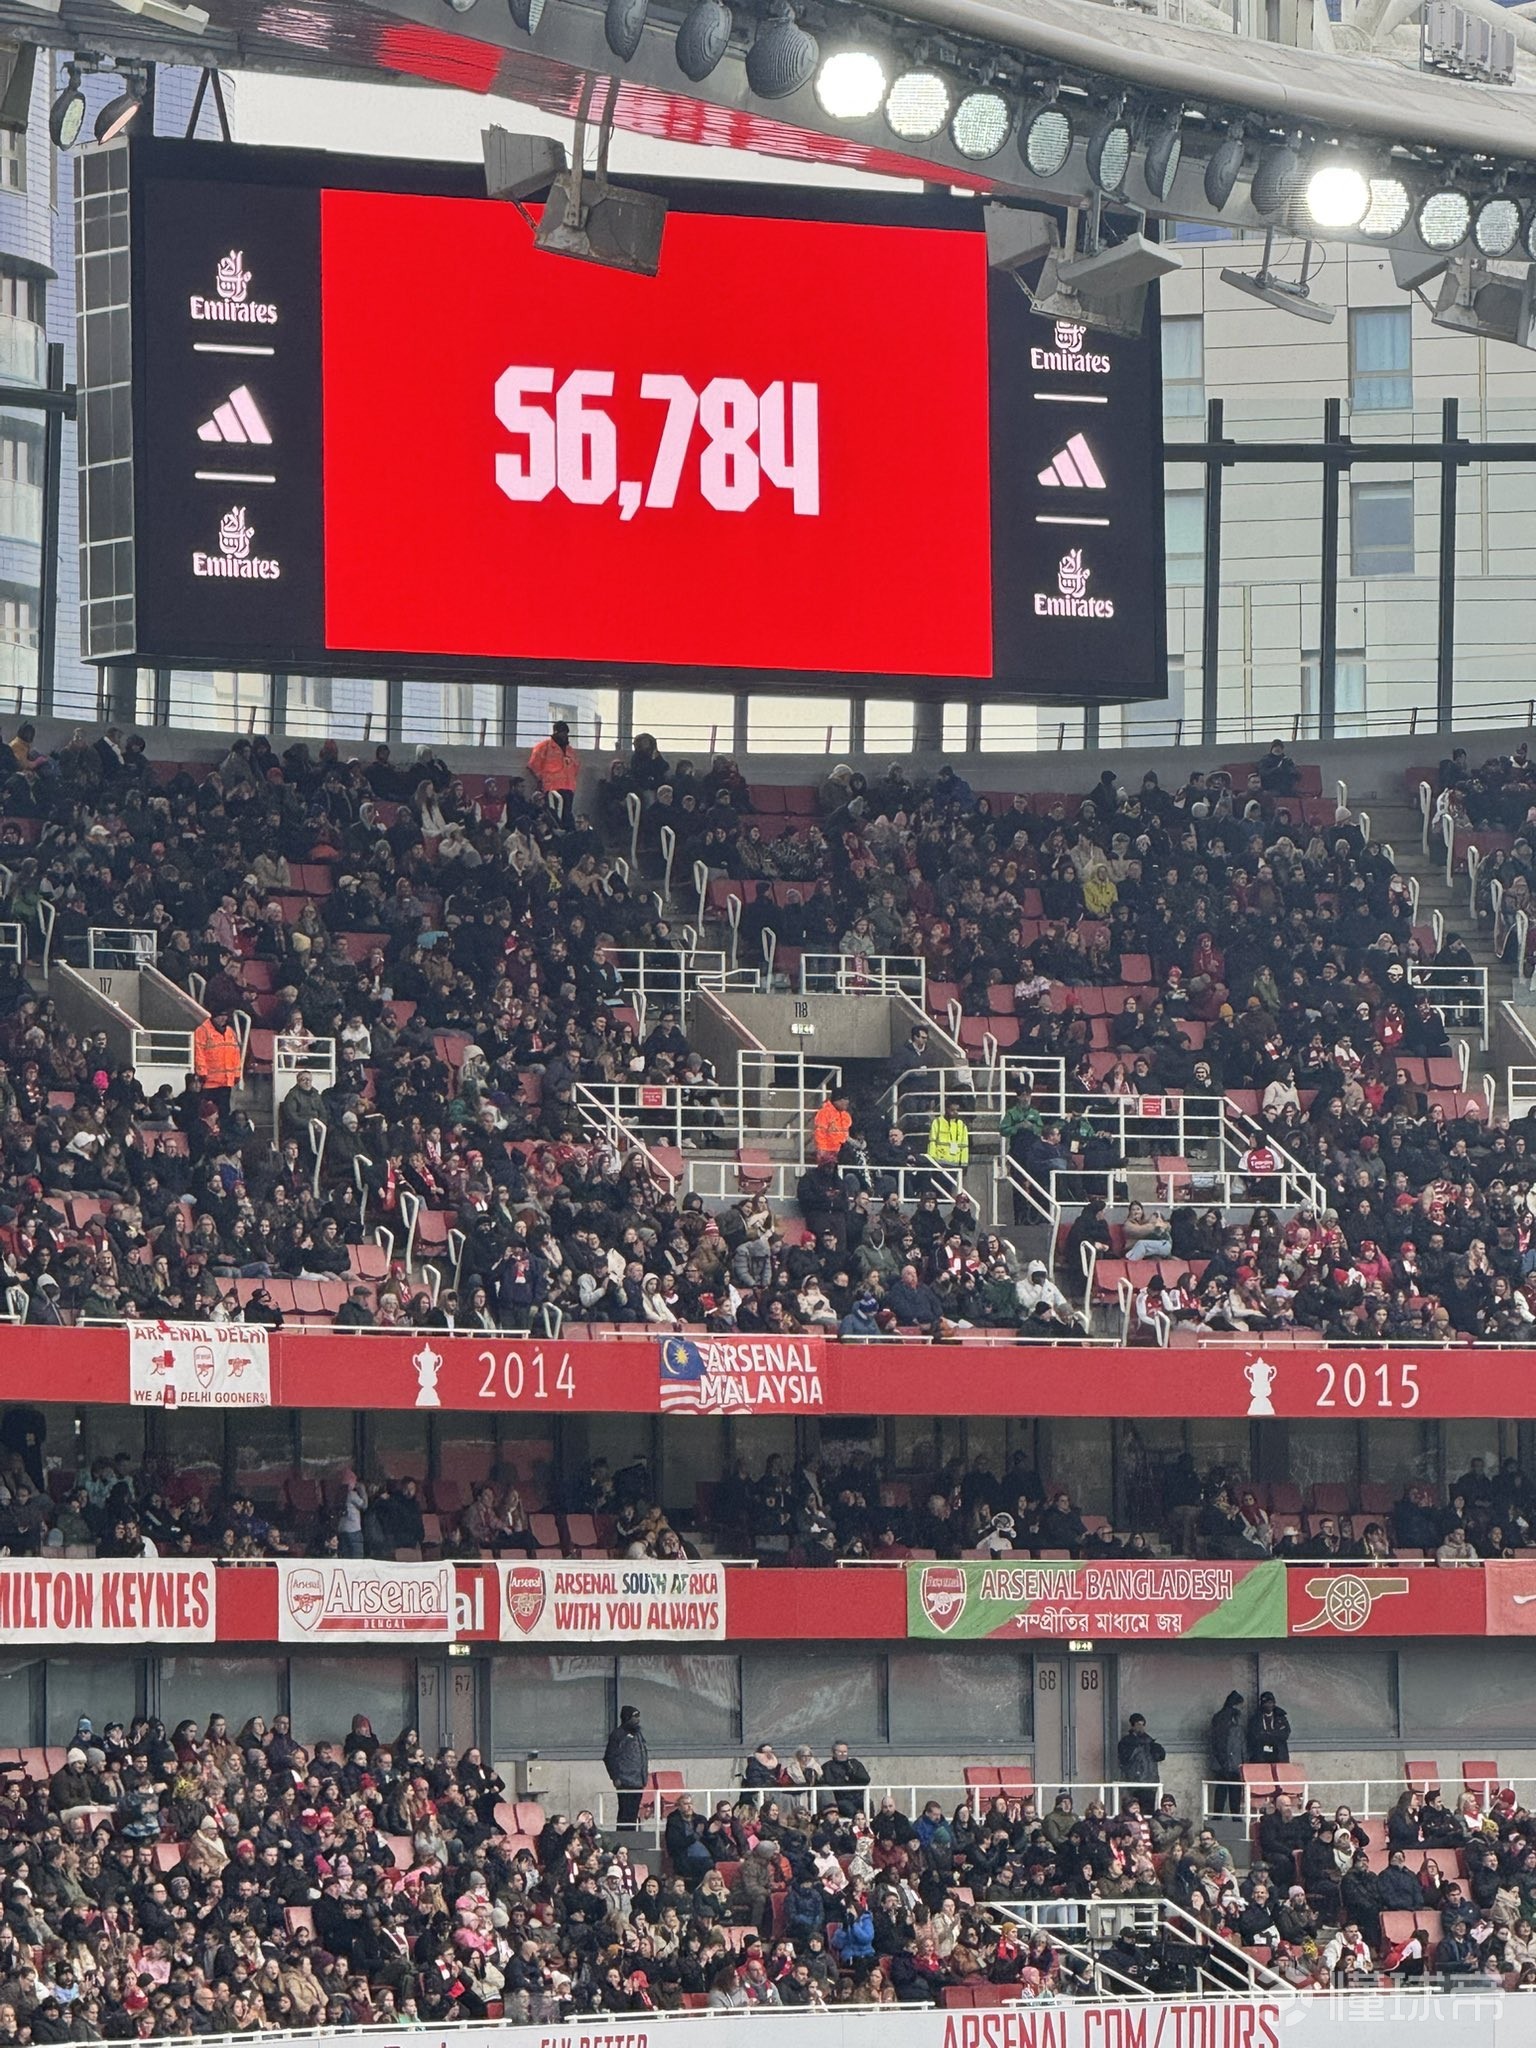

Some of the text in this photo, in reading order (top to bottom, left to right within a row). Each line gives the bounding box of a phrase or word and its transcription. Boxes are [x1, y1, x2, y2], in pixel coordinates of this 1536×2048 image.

[190, 296, 278, 324] Emirates
[1030, 347, 1111, 373] Emirates
[494, 365, 820, 521] 56,784
[193, 552, 280, 579] Emirates
[1034, 593, 1114, 618] Emirates
[795, 1002, 808, 1018] 118
[706, 1343, 818, 1373] ARSENAL
[478, 1351, 576, 1399] 2014
[1315, 1362, 1420, 1409] 2015
[134, 1390, 152, 1402] WE
[181, 1392, 211, 1403] DELHI
[700, 1375, 823, 1405] MALAYSIA
[325, 1568, 449, 1614] Arsenal
[554, 1573, 618, 1595] ARSENAL
[622, 1573, 668, 1595] SOUTH
[980, 1568, 1233, 1600] ARSENAL BANGLADESH
[102, 1571, 209, 1629] KEYNES
[554, 1602, 719, 1631] WITH YOU ALWAYS
[1039, 1670, 1056, 1690] 68
[1081, 1669, 1098, 1690] 68
